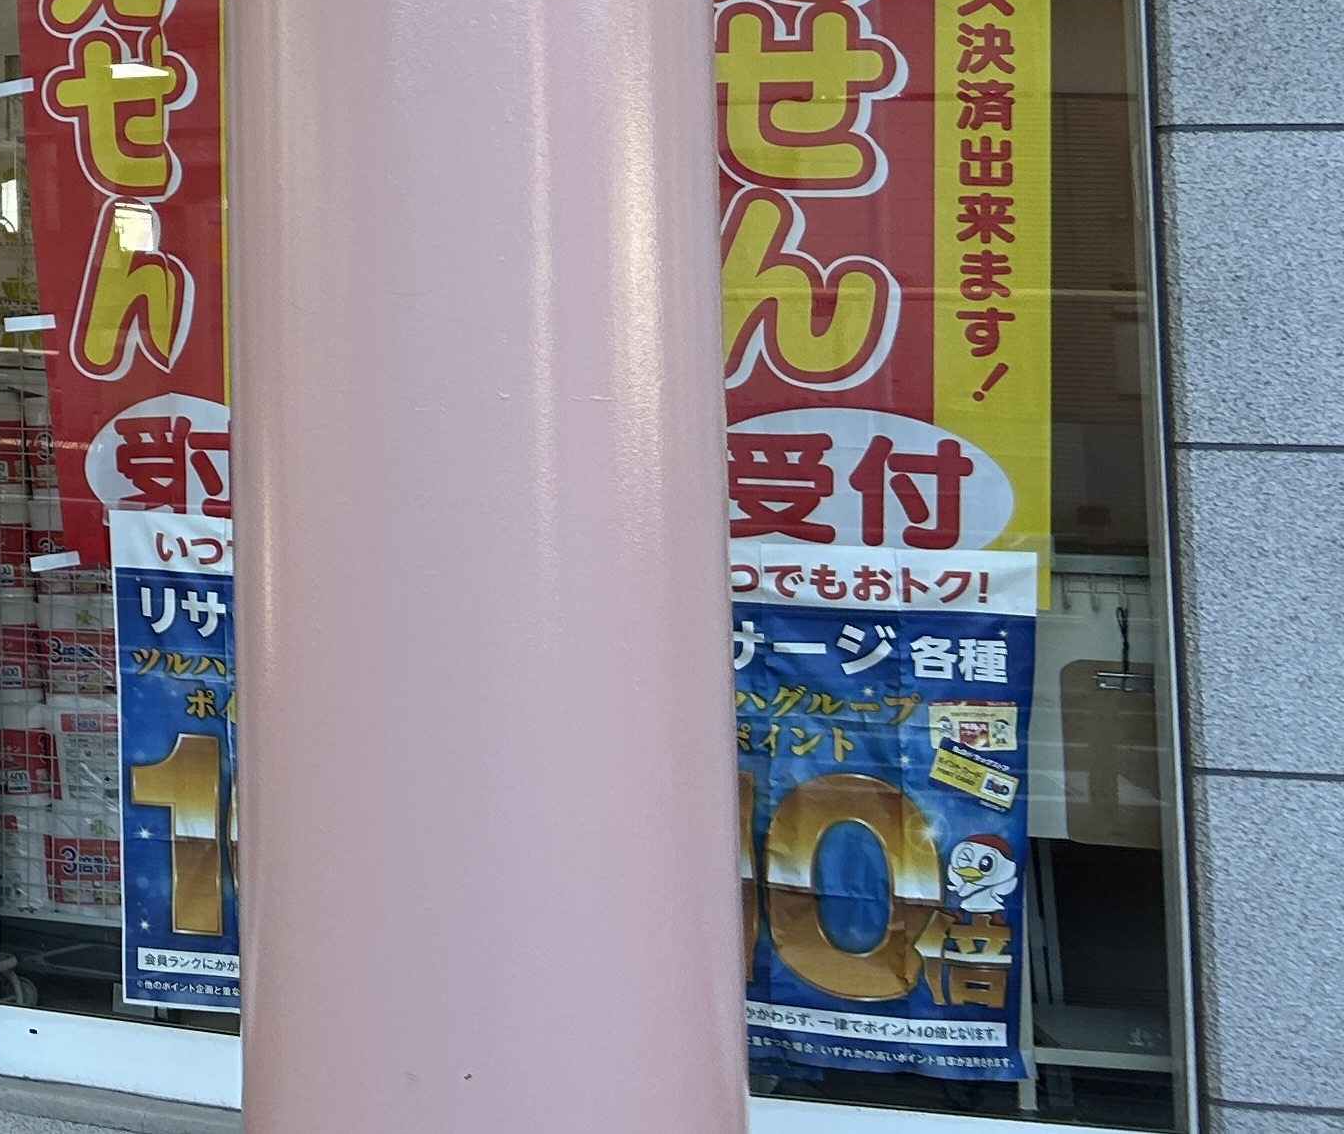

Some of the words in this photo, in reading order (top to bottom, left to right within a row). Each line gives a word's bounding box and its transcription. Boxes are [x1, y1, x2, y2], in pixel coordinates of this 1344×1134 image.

[728, 432, 974, 549] 受付
[156, 532, 233, 565] いつ
[910, 634, 1008, 684] 各種
